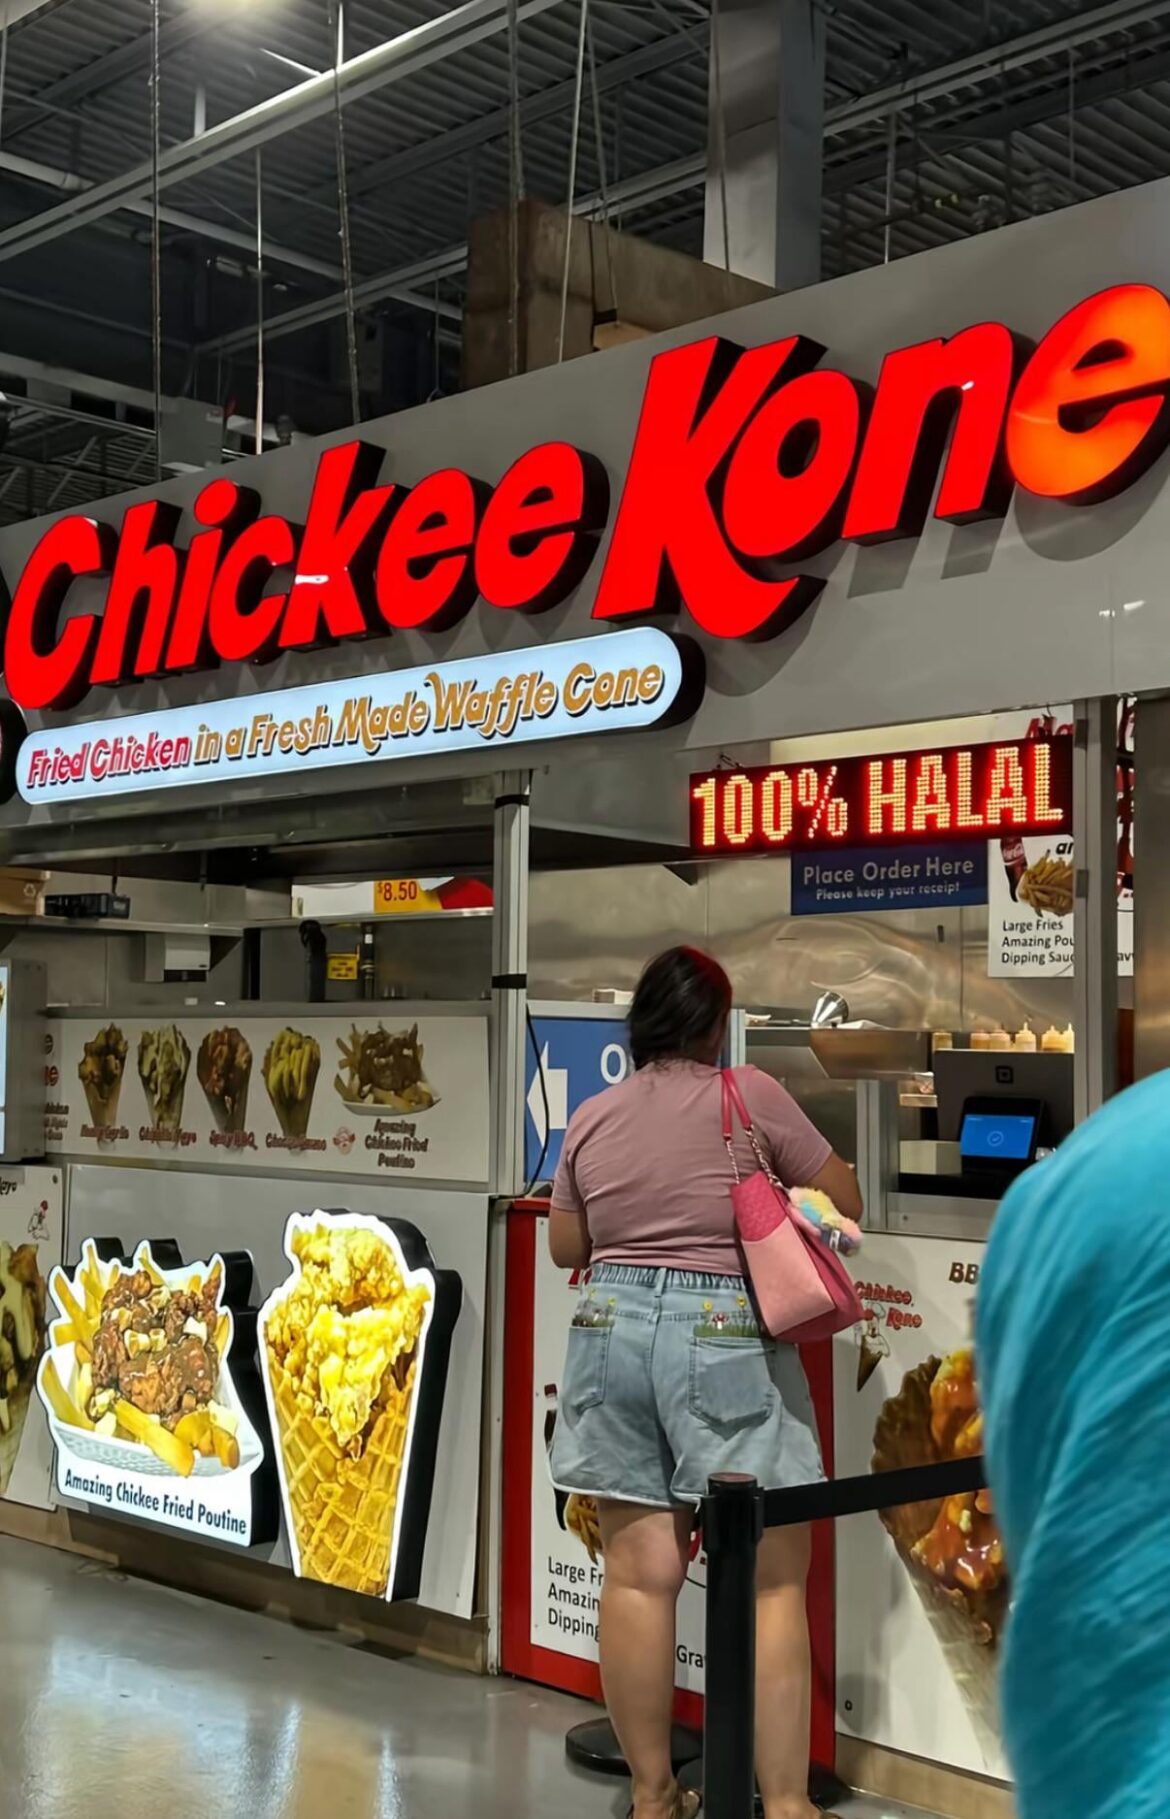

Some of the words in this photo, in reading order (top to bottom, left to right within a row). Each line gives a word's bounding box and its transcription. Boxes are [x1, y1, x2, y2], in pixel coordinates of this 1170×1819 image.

[4, 440, 590, 710] Chickee
[591, 282, 1170, 639] Kone
[26, 742, 92, 788] Fried
[89, 730, 192, 781] Chicken
[193, 723, 222, 765] in
[225, 726, 248, 759] a
[246, 705, 333, 757] Fresh
[333, 691, 431, 756] Made
[423, 670, 558, 740] Waffle
[562, 662, 666, 715] Cone
[692, 765, 849, 846] 100%
[867, 743, 1065, 834] HALAL
[803, 864, 855, 885] Place
[862, 858, 920, 881] Order
[926, 855, 975, 876] Here
[377, 880, 418, 902] $8.50
[816, 888, 852, 901] Please
[856, 886, 885, 900] keep
[889, 885, 915, 898] your
[919, 881, 960, 895] receipt
[1001, 935, 1051, 949] Amazing
[1054, 934, 1074, 947] Pou
[1002, 919, 1033, 934] Large
[1036, 919, 1064, 931] Fries
[1001, 951, 1046, 966] Dipping
[1050, 952, 1074, 963] Sauc
[600, 1043, 634, 1084] O
[949, 1261, 980, 1285] BB
[65, 1468, 113, 1503] Amazing
[116, 1481, 159, 1512] Chickee
[163, 1494, 193, 1521] Fried
[197, 1503, 247, 1535] Poutine
[548, 1556, 586, 1584] Large
[590, 1570, 604, 1588] Fr
[548, 1582, 602, 1612] Amazin
[548, 1608, 602, 1643] Dipping
[676, 1644, 706, 1668] Gra
